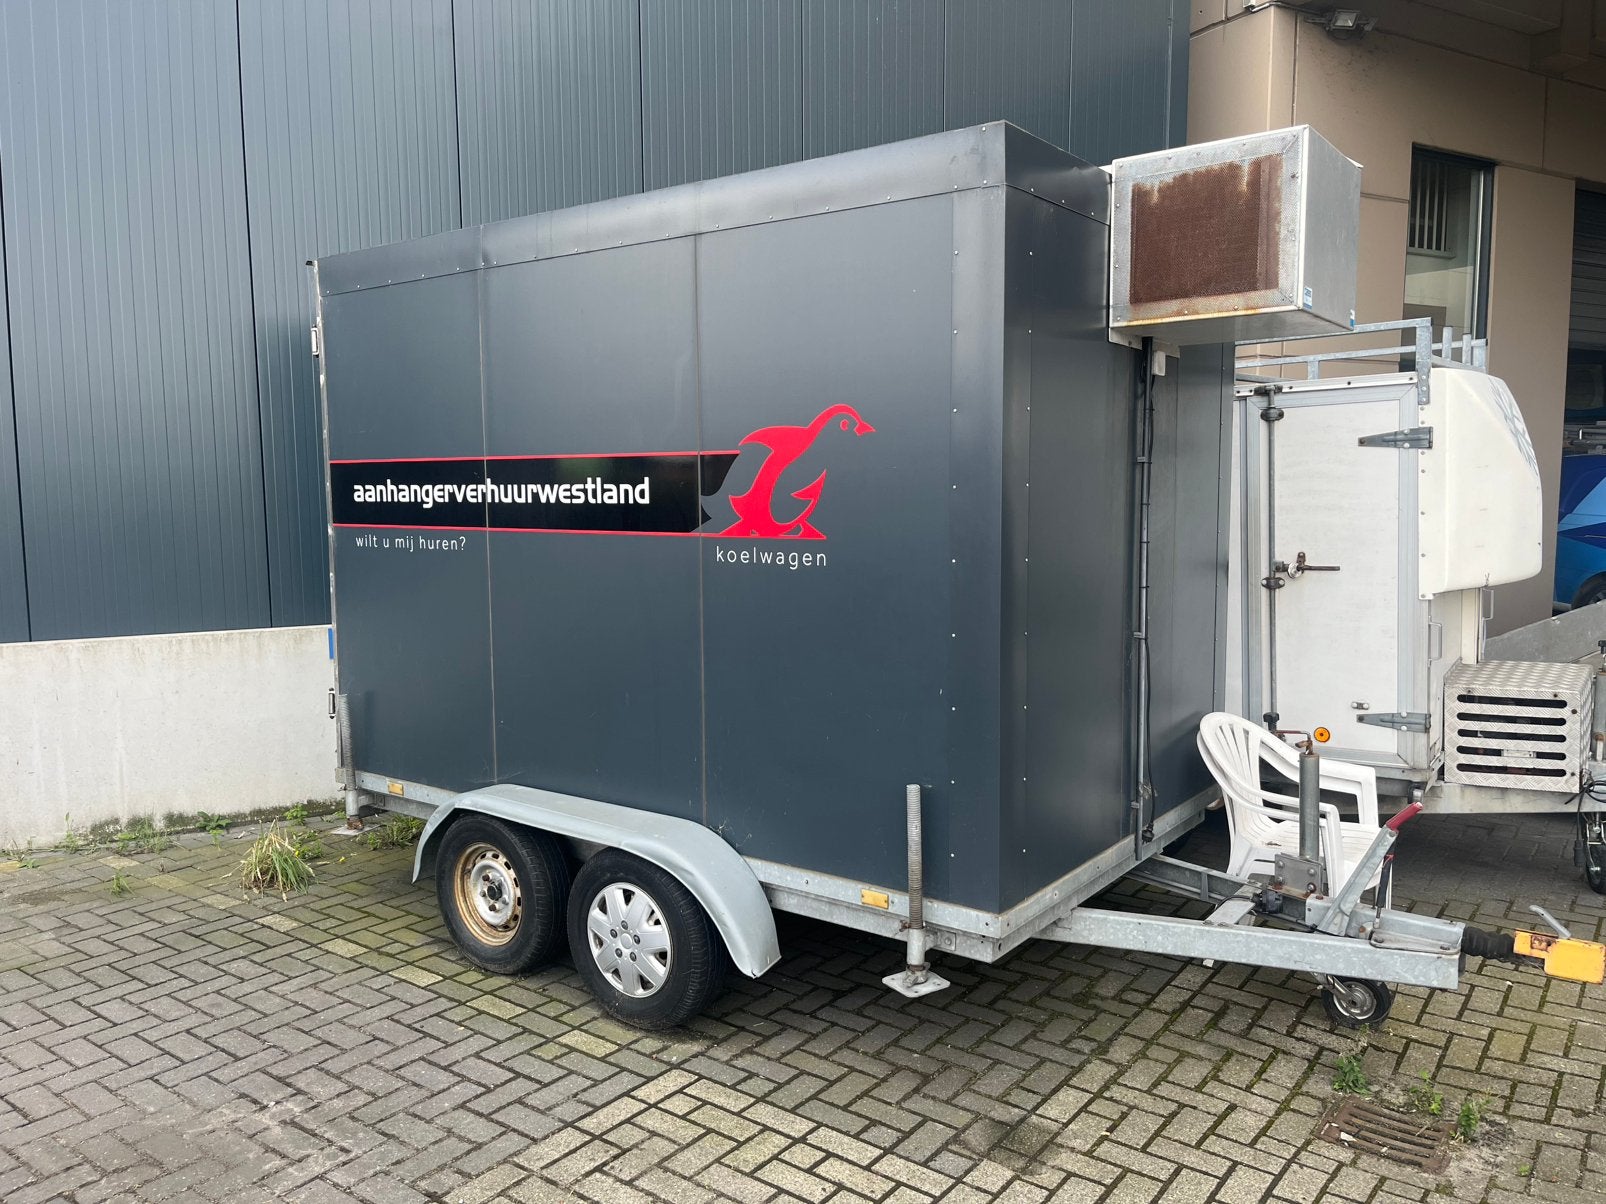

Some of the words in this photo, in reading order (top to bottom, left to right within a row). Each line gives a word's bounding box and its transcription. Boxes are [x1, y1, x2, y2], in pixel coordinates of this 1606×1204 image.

[353, 476, 650, 509] aanhangerverhuurwestland
[355, 534, 378, 548] wilt
[383, 538, 390, 548] u
[395, 535, 414, 552] mij
[419, 536, 466, 551] huren?
[716, 545, 827, 570] koelwagen
